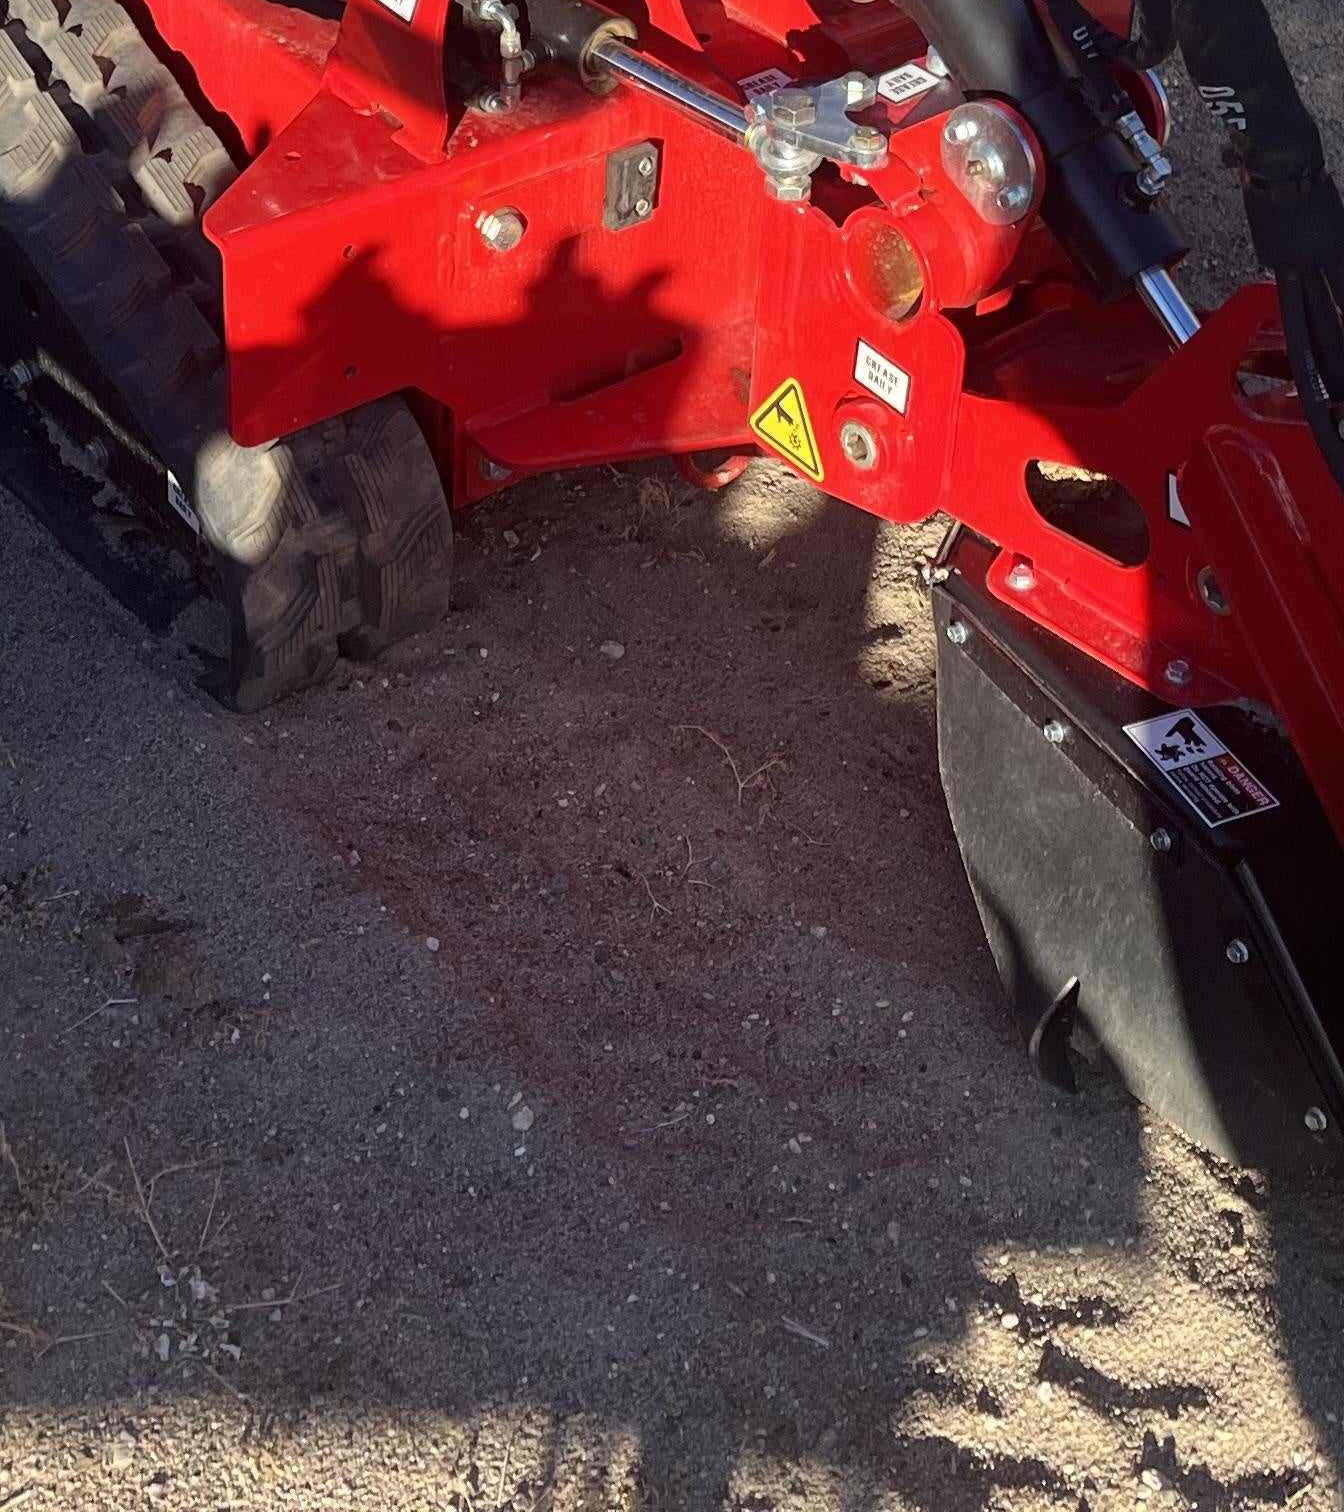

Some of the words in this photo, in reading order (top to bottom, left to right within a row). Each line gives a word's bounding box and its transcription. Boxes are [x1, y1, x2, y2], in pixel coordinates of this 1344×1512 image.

[865, 355, 900, 388] GREASE
[868, 370, 893, 395] DAILY
[1227, 764, 1270, 806] DANGER
